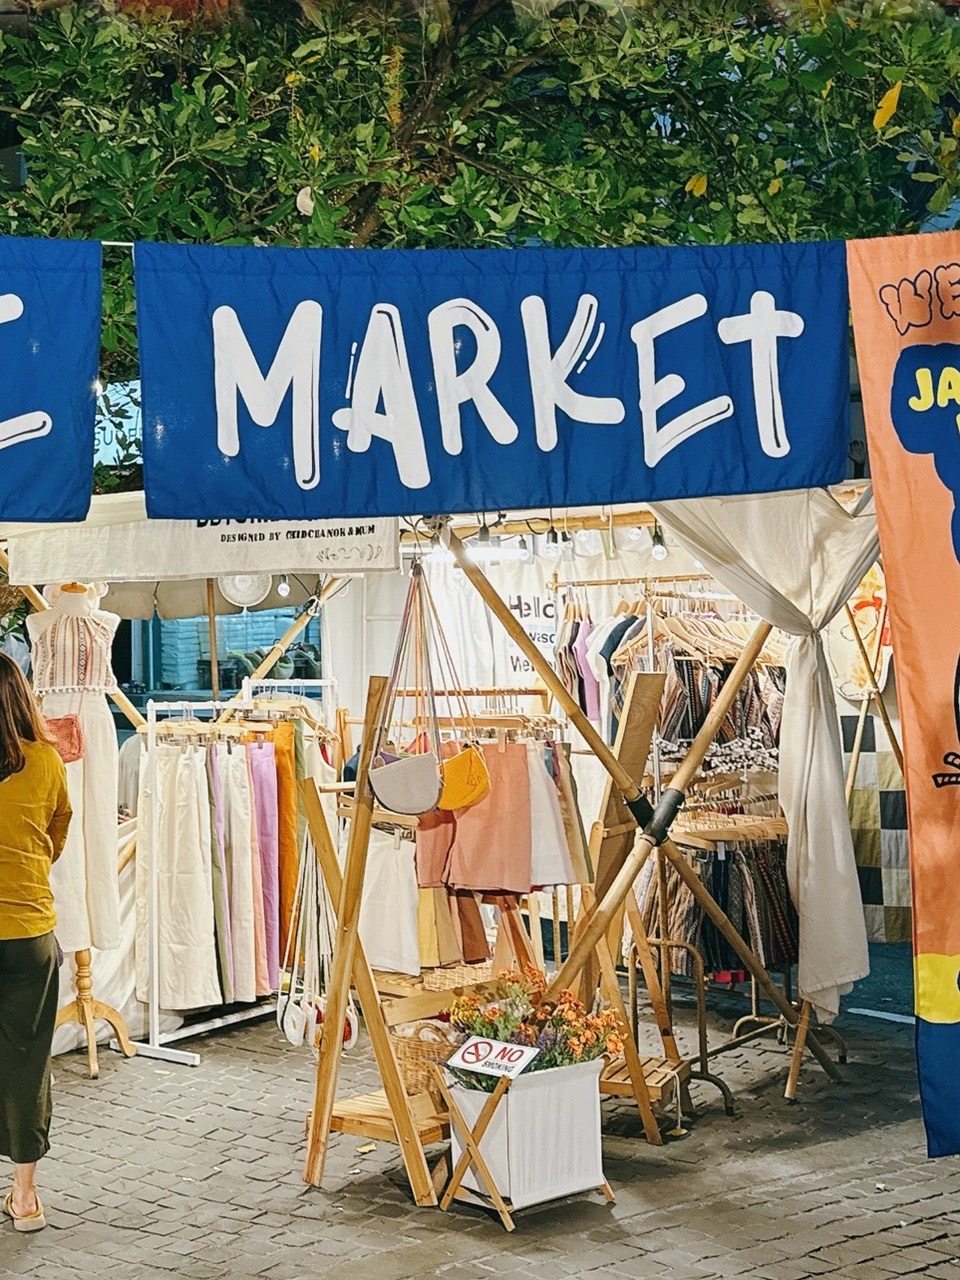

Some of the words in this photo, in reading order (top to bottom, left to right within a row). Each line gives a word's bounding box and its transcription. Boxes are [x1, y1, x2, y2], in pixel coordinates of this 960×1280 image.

[878, 262, 960, 336] WE
[212, 290, 805, 490] MARKET
[908, 366, 960, 412] JA
[268, 532, 281, 541] BY
[481, 1060, 516, 1073] SMOKING
[494, 1046, 525, 1063] NO
